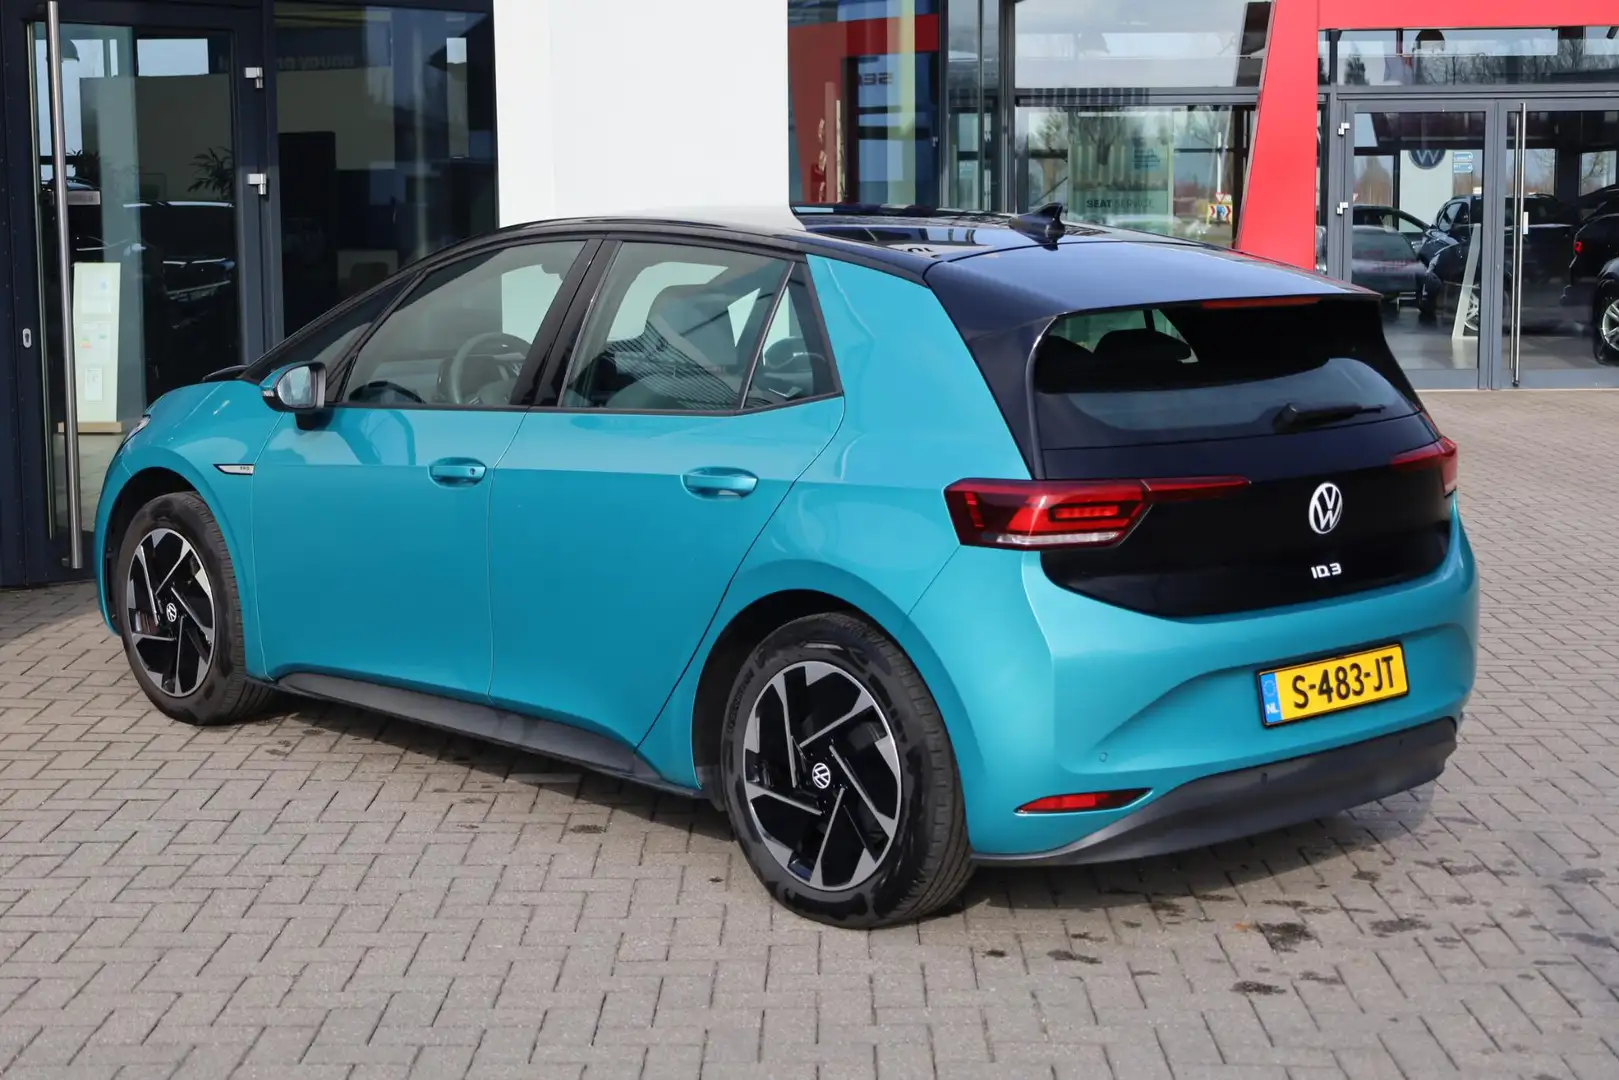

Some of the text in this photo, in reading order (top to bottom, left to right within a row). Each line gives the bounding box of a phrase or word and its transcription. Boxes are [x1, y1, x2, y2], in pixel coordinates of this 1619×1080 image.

[1086, 199, 1111, 208] SEAT
[1309, 482, 1342, 534] VW
[1292, 655, 1393, 709] S-483-JT
[1266, 702, 1280, 714] NL
